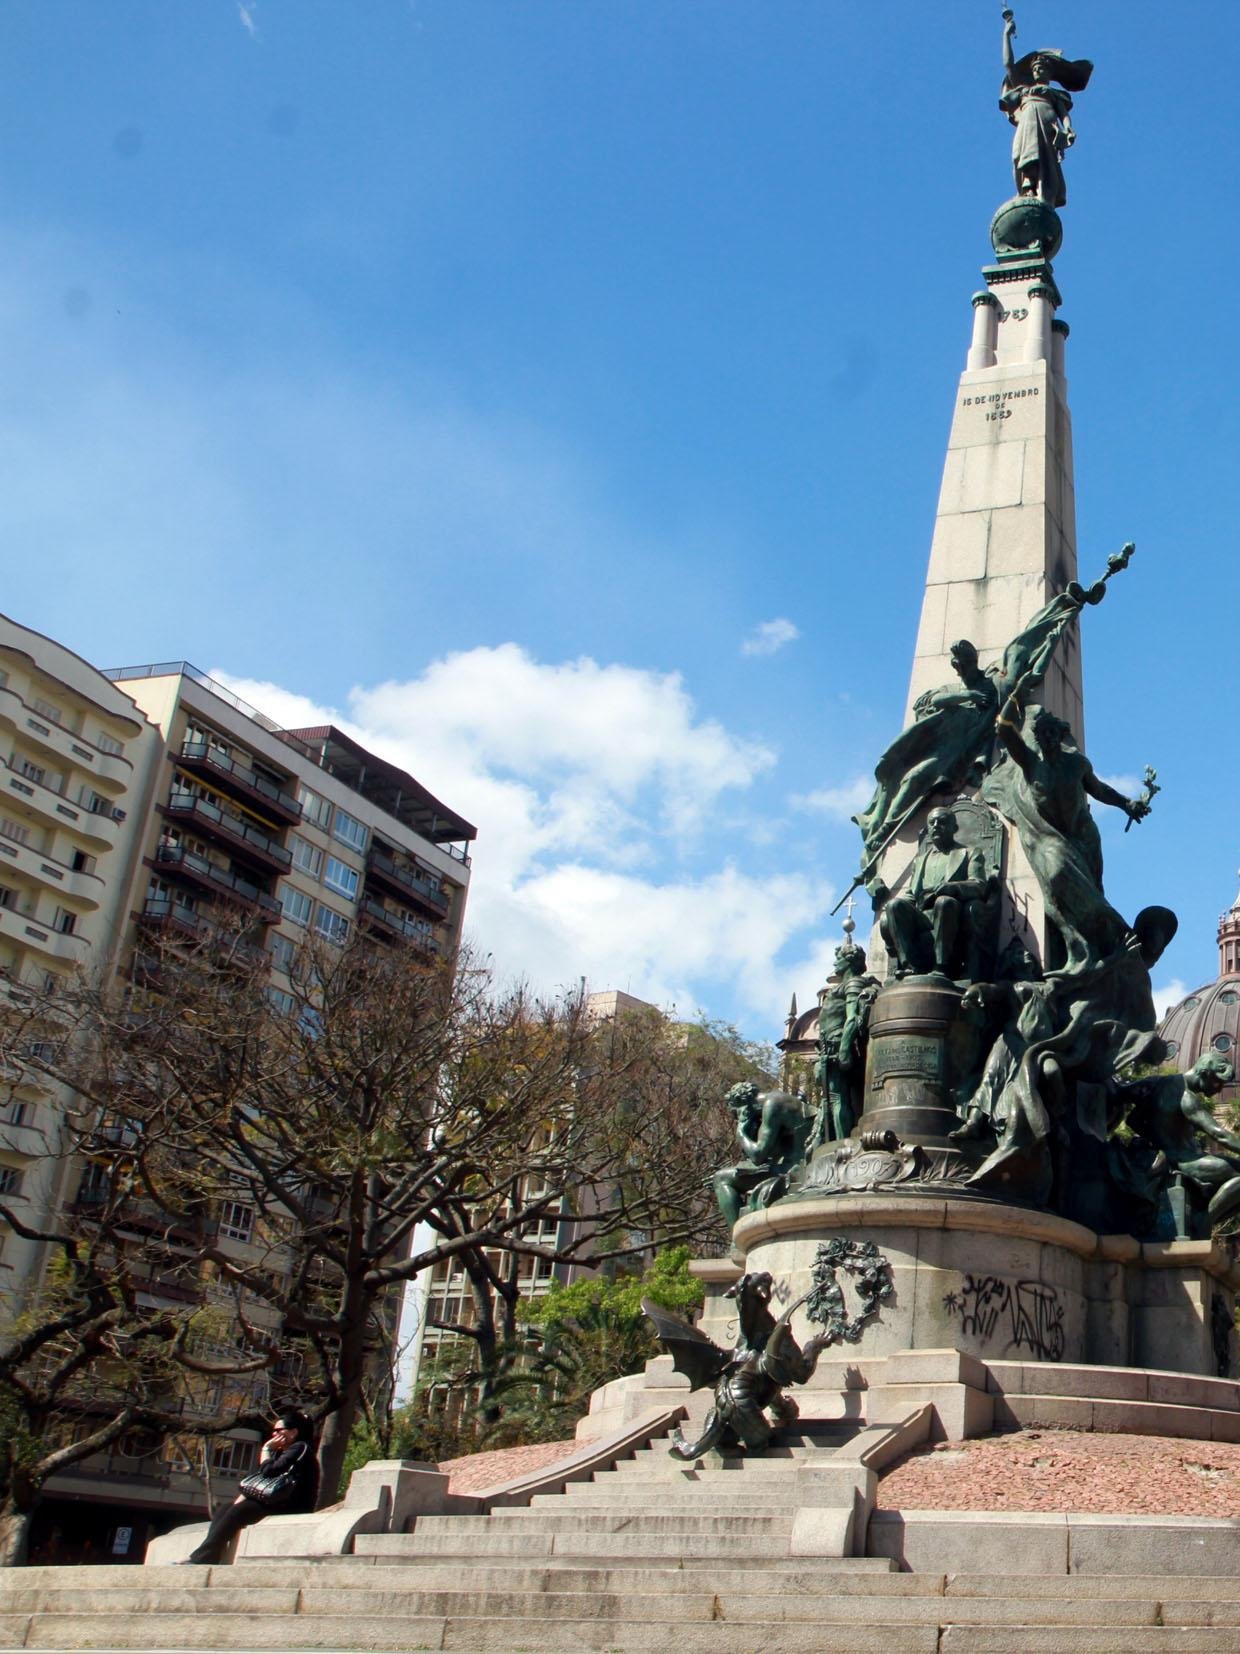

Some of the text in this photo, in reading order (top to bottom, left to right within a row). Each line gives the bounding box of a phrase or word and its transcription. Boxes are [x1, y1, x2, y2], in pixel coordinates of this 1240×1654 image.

[975, 395, 987, 405] DE
[988, 387, 1040, 402] NOVEMBRO
[849, 1159, 895, 1177] 1907
